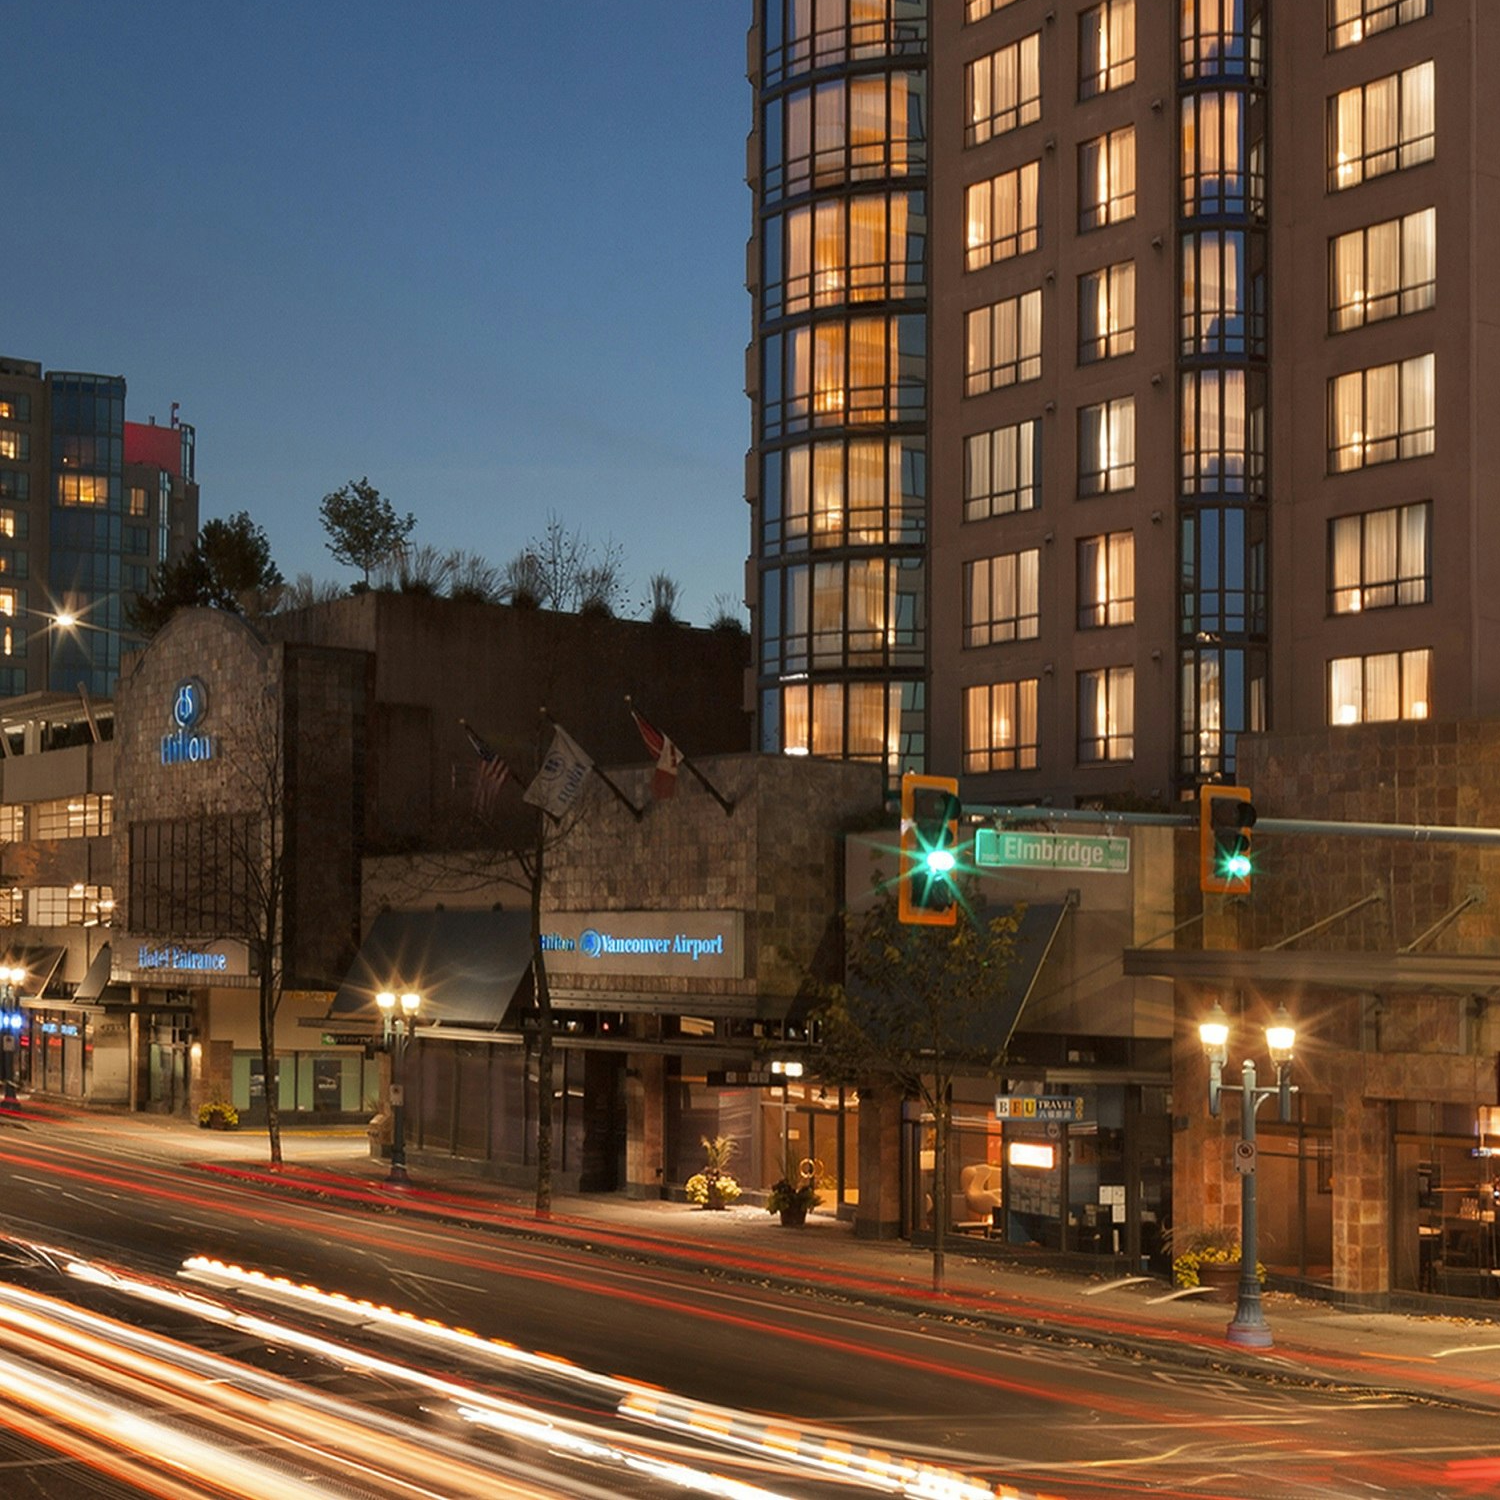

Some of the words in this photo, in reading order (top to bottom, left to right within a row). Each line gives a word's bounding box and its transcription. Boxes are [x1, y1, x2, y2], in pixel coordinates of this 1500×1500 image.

[1004, 837, 1104, 867] Elmbridge
[600, 934, 670, 953] Vancouver
[672, 934, 724, 961] Airport
[1039, 1100, 1072, 1109] TRAVEL
